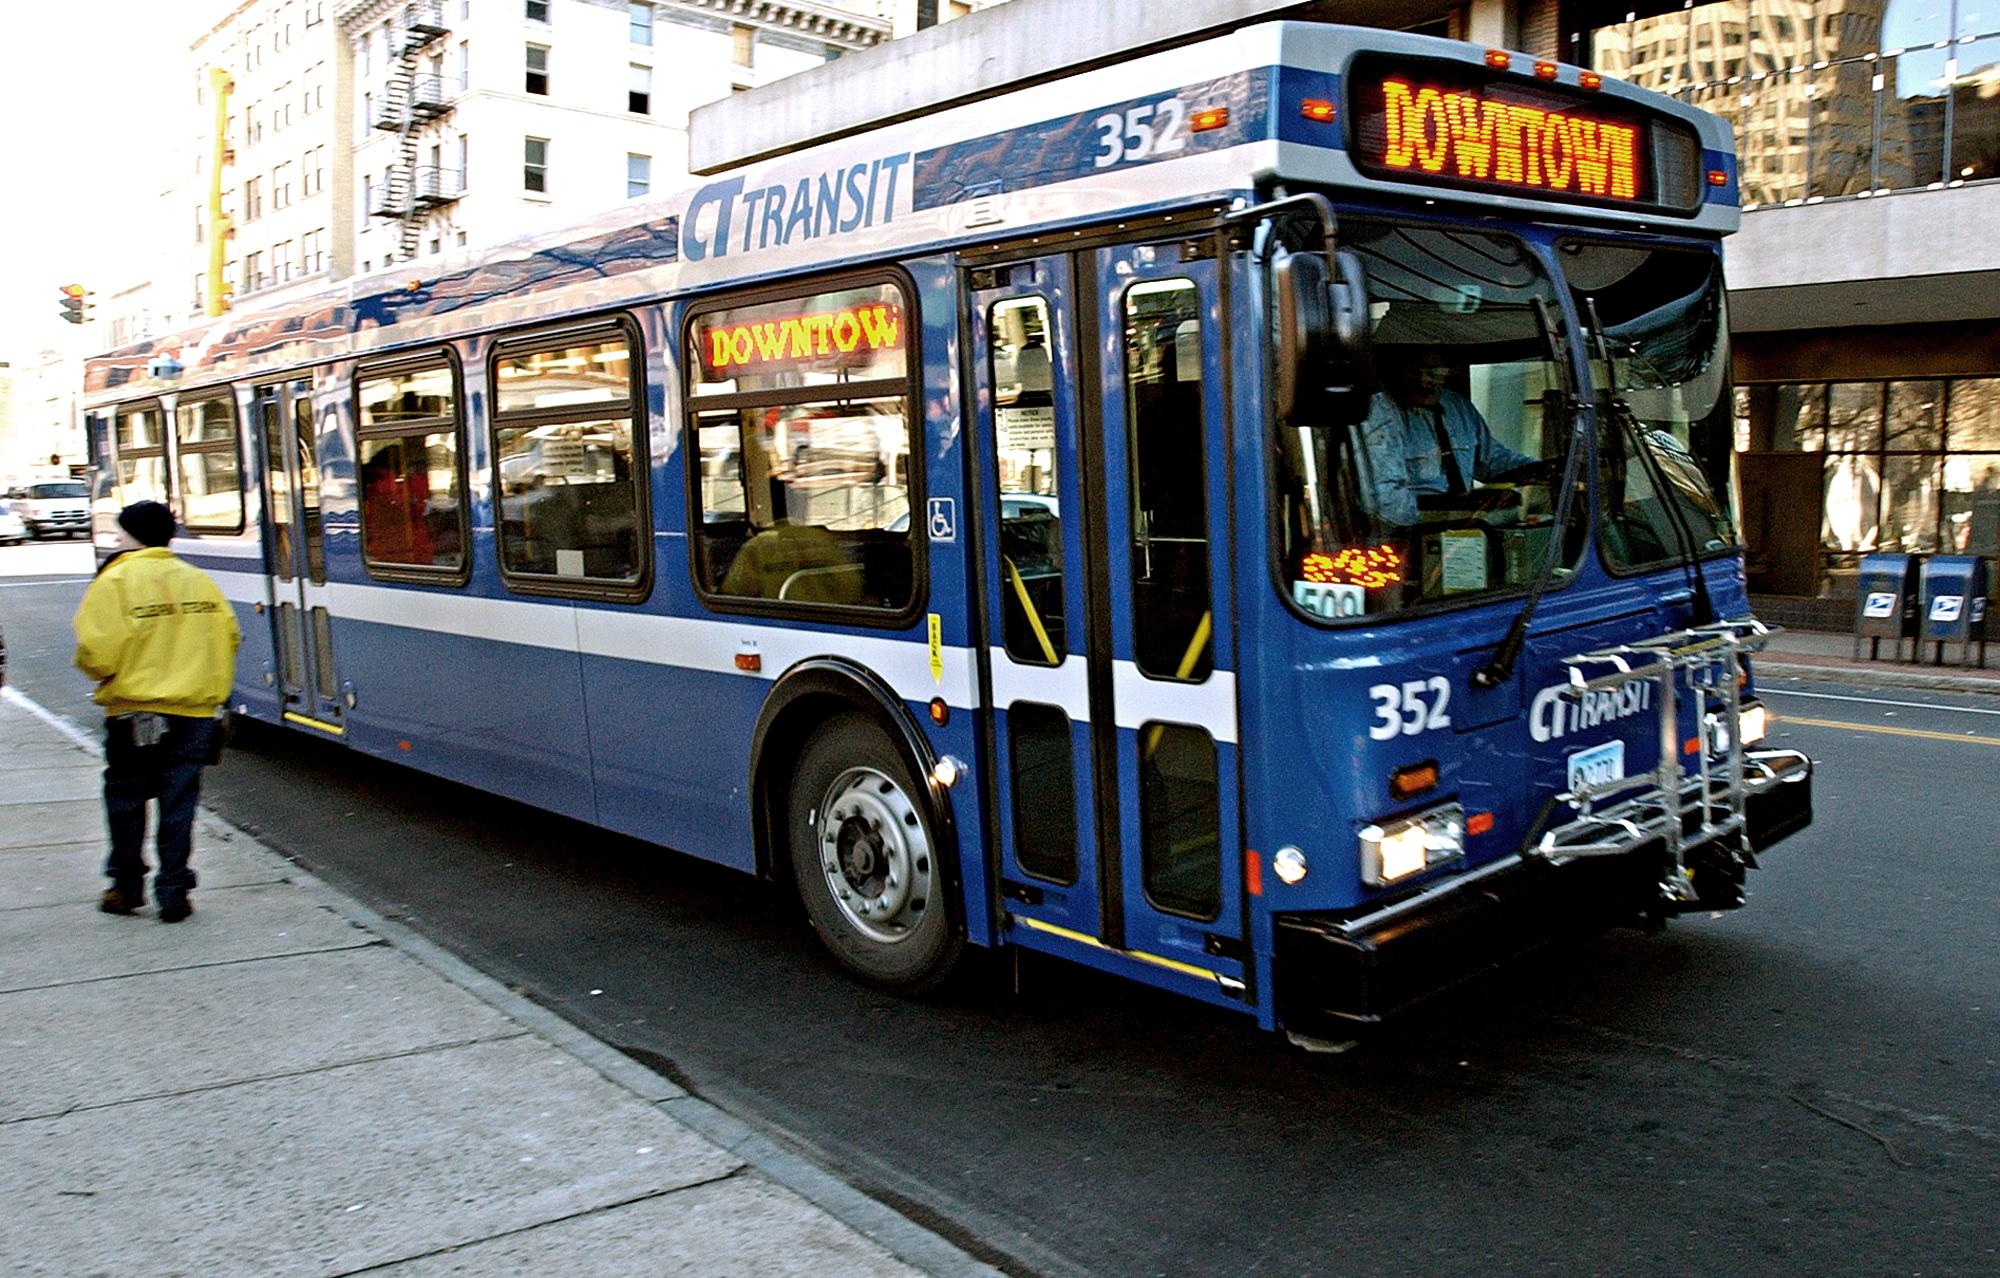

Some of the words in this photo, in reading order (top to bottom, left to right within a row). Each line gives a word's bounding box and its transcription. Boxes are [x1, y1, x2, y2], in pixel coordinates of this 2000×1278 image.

[1094, 98, 1186, 168] 352
[1383, 81, 1635, 198] DOWNTOWN
[743, 151, 911, 252] TRANSIT
[711, 305, 898, 367] DOWNTOW
[1302, 587, 1357, 616] 500
[1369, 675, 1451, 741] 352
